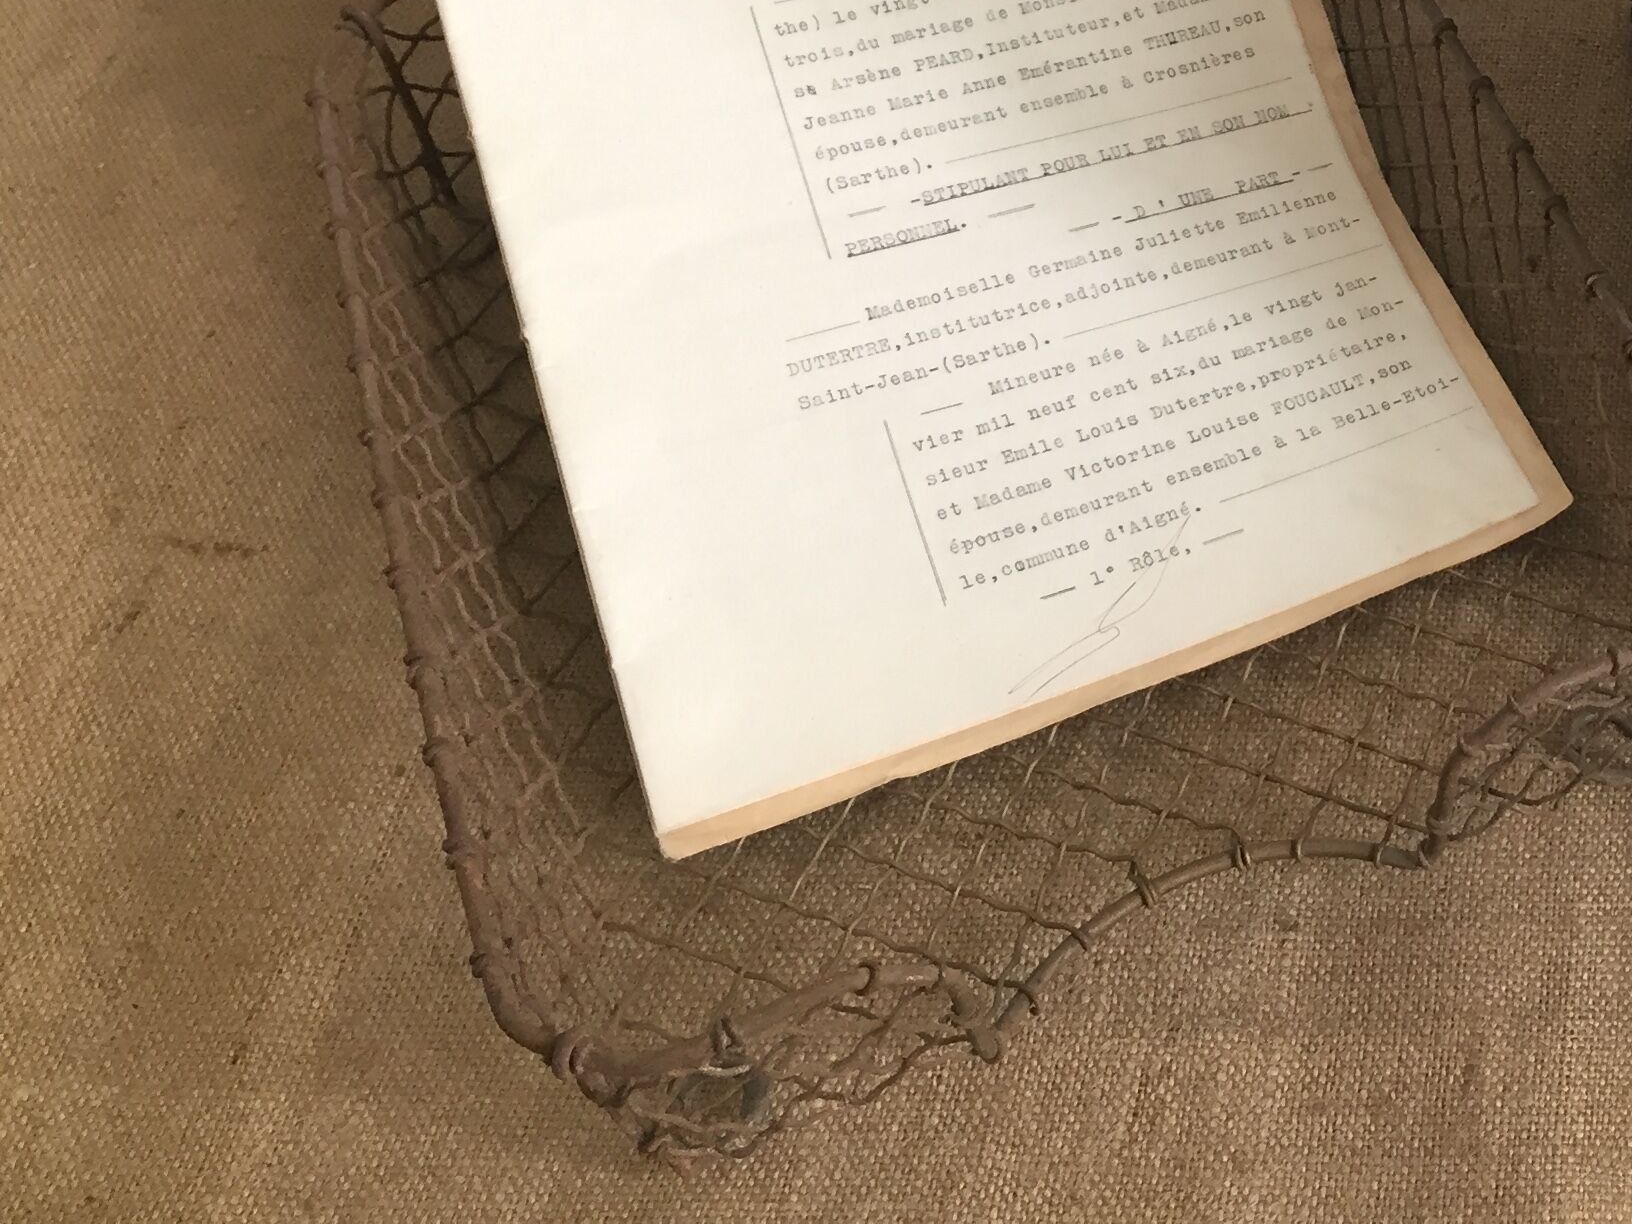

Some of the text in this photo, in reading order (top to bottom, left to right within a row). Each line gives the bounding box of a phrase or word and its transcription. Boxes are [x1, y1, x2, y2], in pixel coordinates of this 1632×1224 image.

[773, 13, 821, 38] the)
[831, 9, 858, 25] le
[890, 16, 975, 45] mariage
[985, 8, 1009, 23] de
[802, 104, 877, 131] Jeanne
[885, 88, 949, 112] Marie
[961, 74, 1008, 96] Anne
[1016, 44, 1133, 81] Emérantine
[831, 66, 902, 91] Arsène
[1019, 83, 1109, 114] ensemble
[1120, 75, 1135, 90] à
[1142, 47, 1256, 85] Crosnières
[825, 156, 933, 195] (Sarthe).
[1039, 153, 1094, 179] POUR
[1096, 142, 1138, 165] LUI
[1142, 133, 1173, 154] ET
[1175, 125, 1205, 146] EN
[1211, 114, 1251, 137] SON
[1177, 170, 1285, 210] UNE PART
[864, 191, 1337, 322] Mademoiselle Germaine Juliette Emilienne
[1282, 231, 1297, 246] à
[1303, 216, 1361, 240] Mont-
[987, 361, 1076, 396] Mineure
[1087, 347, 1125, 368] née
[1135, 338, 1151, 354] à
[1263, 289, 1323, 316] vingt
[1334, 276, 1378, 298] jan-
[911, 428, 965, 452] vier
[975, 413, 1016, 436] mil
[1026, 394, 1077, 421] neuf
[1089, 377, 1139, 403] cent
[1231, 327, 1314, 361] mariage
[1325, 316, 1348, 330] de
[1356, 299, 1404, 321] Mon-
[925, 458, 989, 487] sieur
[1000, 436, 1065, 465] Emile
[1075, 414, 1140, 444] Louis
[1165, 444, 1263, 486] ensemble
[1272, 434, 1288, 450] à
[1295, 425, 1322, 443] la
[1330, 375, 1460, 430] Belle-Etoi-
[936, 501, 963, 521] et
[972, 477, 1053, 511] Madame
[1063, 439, 1177, 481] Victorine
[1186, 411, 1260, 445] Louise
[1104, 500, 1202, 543] d'Aigné.
